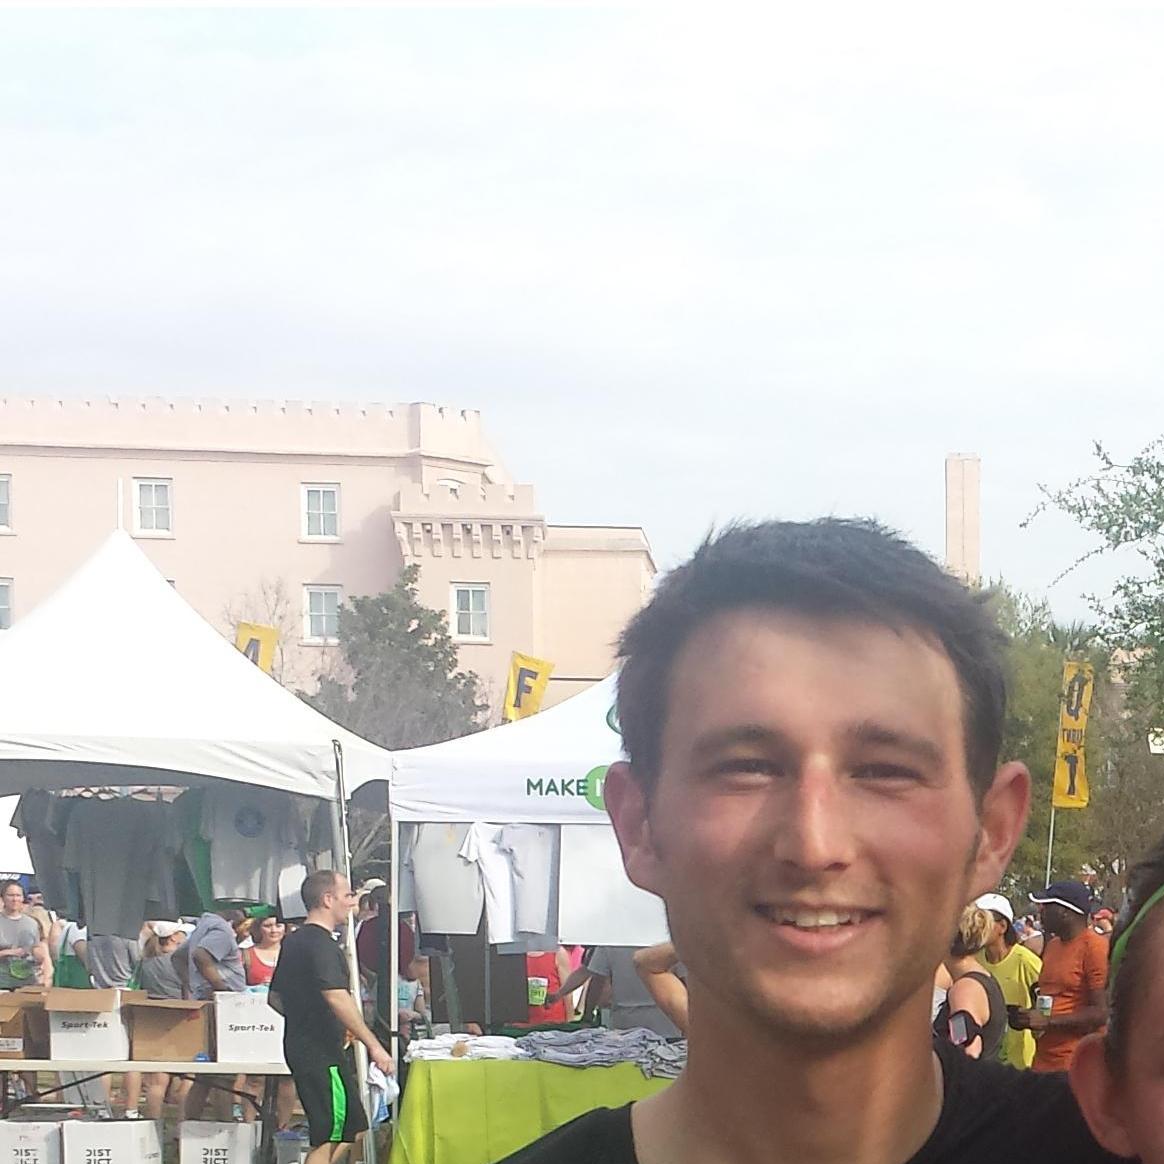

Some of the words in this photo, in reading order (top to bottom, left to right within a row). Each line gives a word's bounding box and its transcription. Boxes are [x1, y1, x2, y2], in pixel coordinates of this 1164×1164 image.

[513, 667, 538, 708] F
[526, 778, 588, 797] MAKE
[60, 1020, 109, 1030] Sport-Tek
[228, 1024, 275, 1032] Sport-Tek
